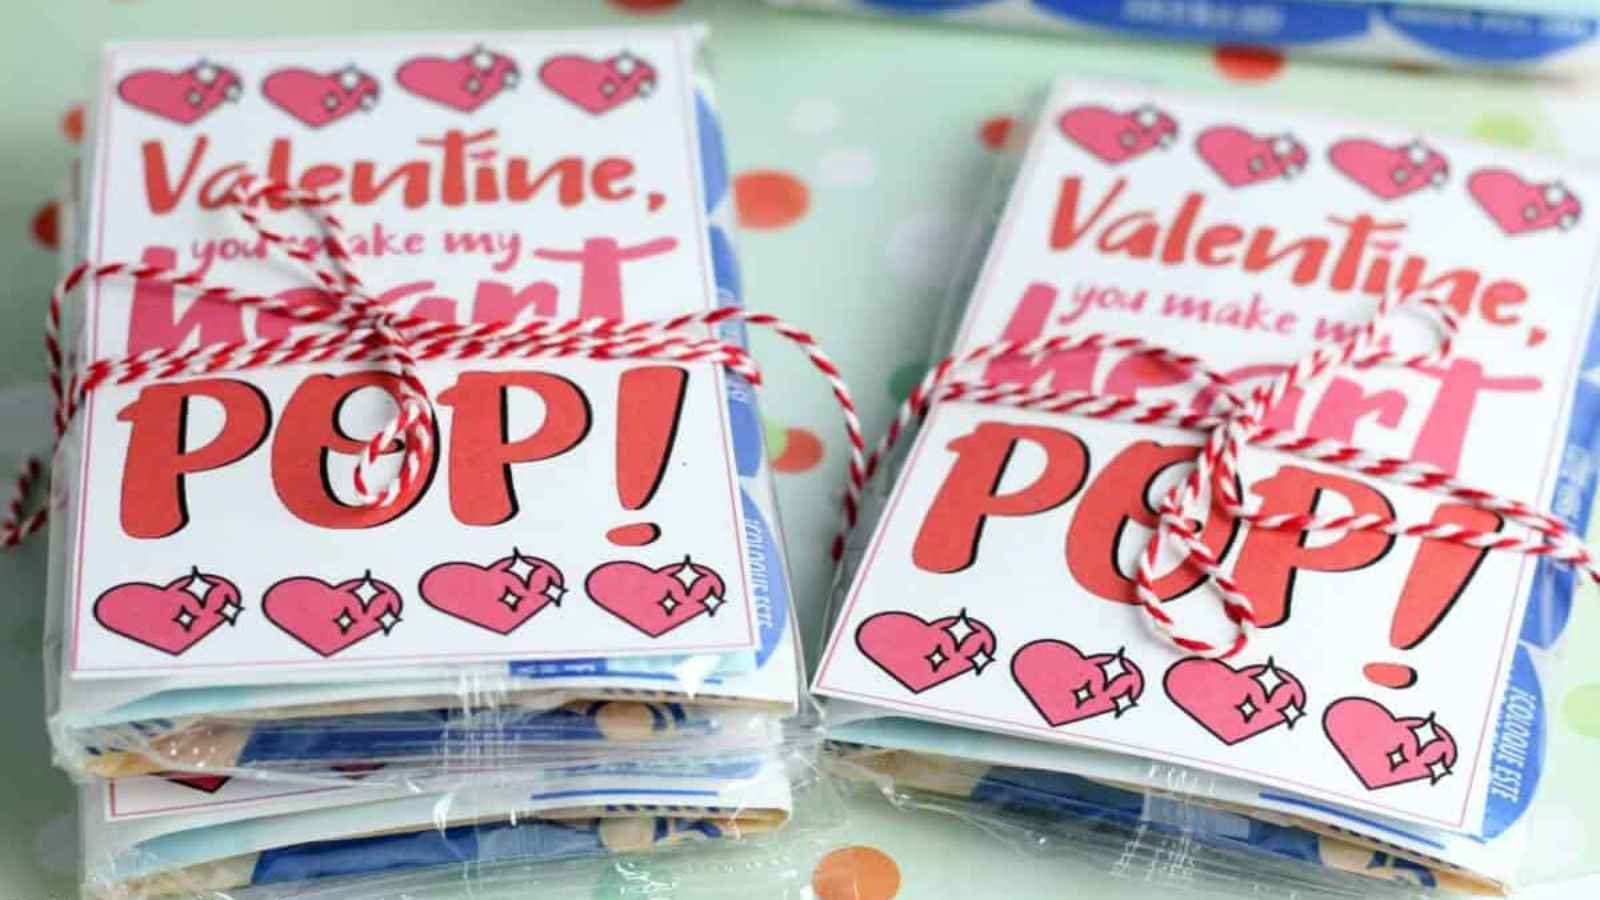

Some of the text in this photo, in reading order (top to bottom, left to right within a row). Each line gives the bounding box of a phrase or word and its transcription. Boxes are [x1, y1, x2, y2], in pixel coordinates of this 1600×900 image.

[142, 129, 666, 216] Valentine,
[191, 237, 268, 284] you
[445, 230, 521, 272] my
[1049, 175, 1547, 349] Valentine,
[1058, 283, 1148, 325] you
[1161, 291, 1298, 335] make
[116, 365, 690, 547] POP!
[912, 420, 1503, 690] POP!
[1491, 765, 1521, 803] ESTE
